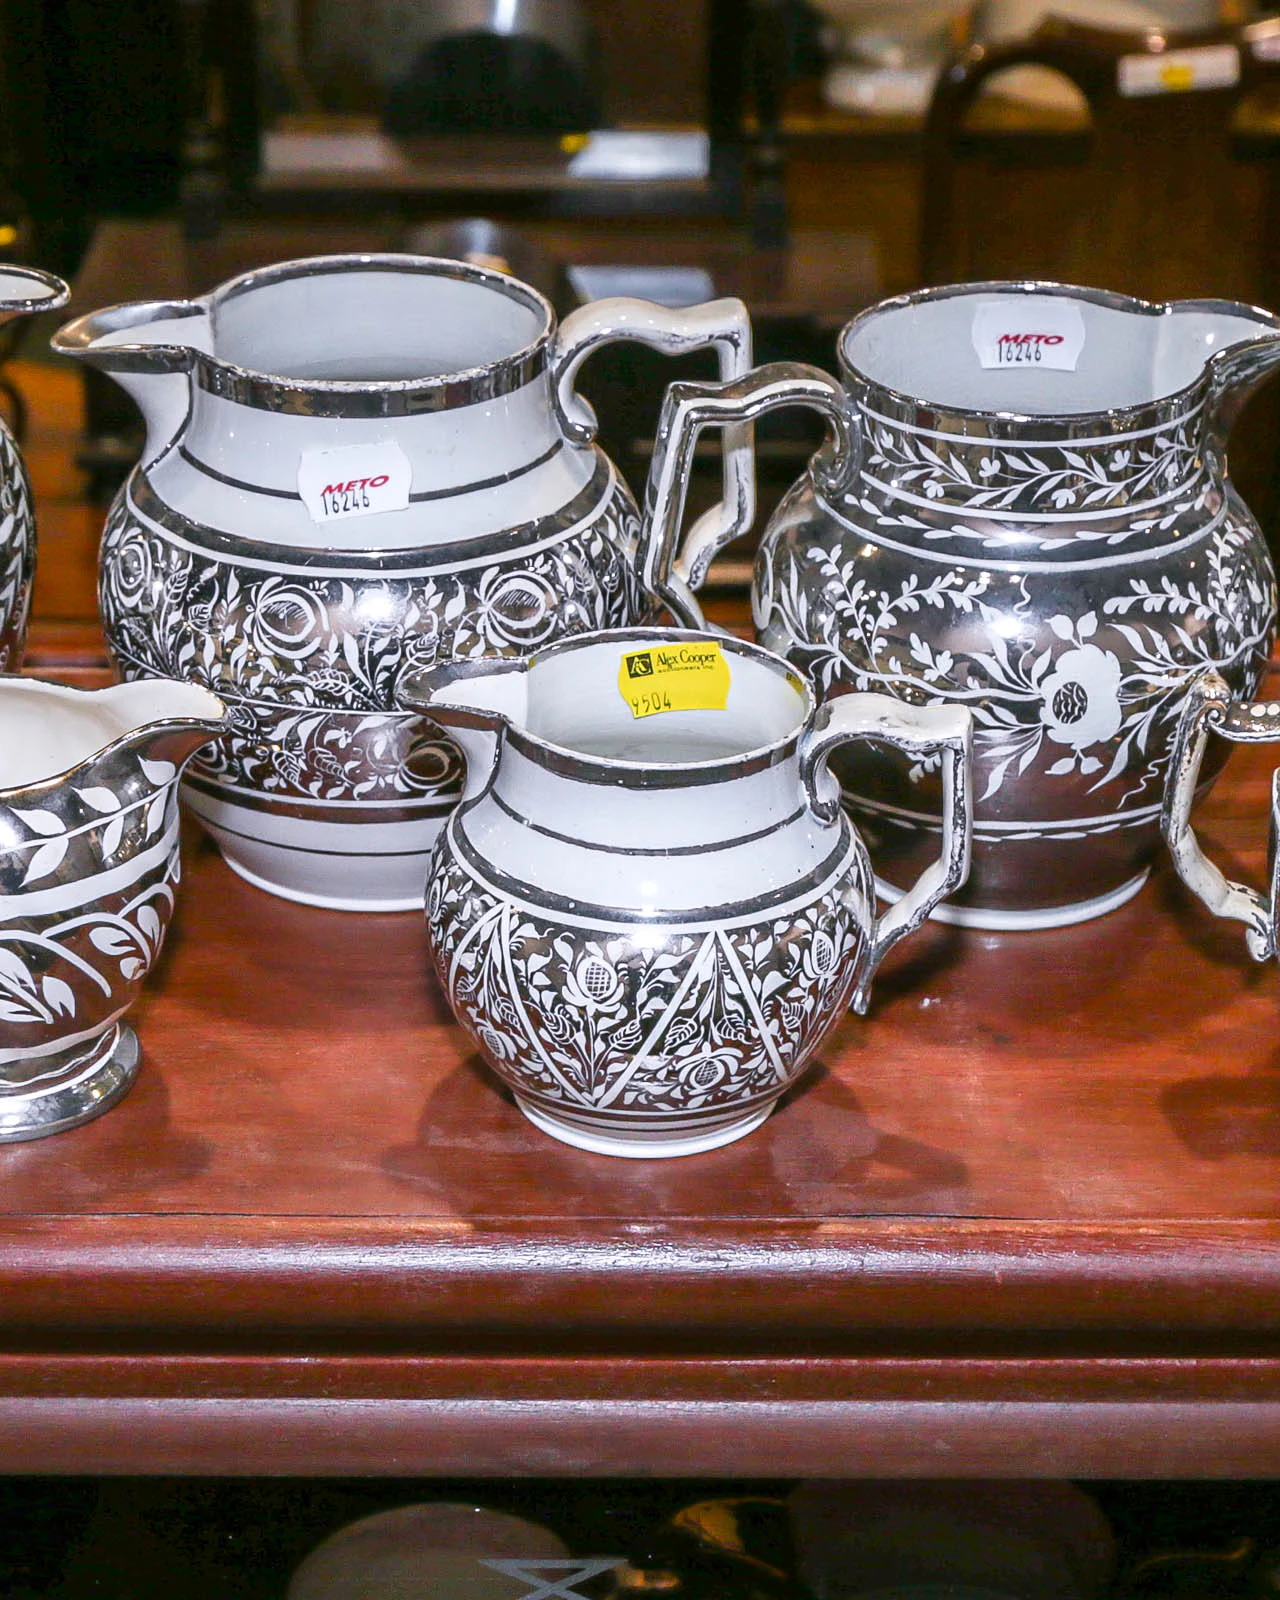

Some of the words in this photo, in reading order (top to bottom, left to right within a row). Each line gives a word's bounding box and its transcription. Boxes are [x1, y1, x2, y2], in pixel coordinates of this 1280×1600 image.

[997, 333, 1065, 345] METO
[999, 342, 1042, 363] 16246
[320, 475, 390, 497] METO
[322, 487, 370, 515] 16246
[656, 651, 679, 668] Alex
[680, 649, 717, 665] Cooper
[632, 691, 672, 715] 9504
